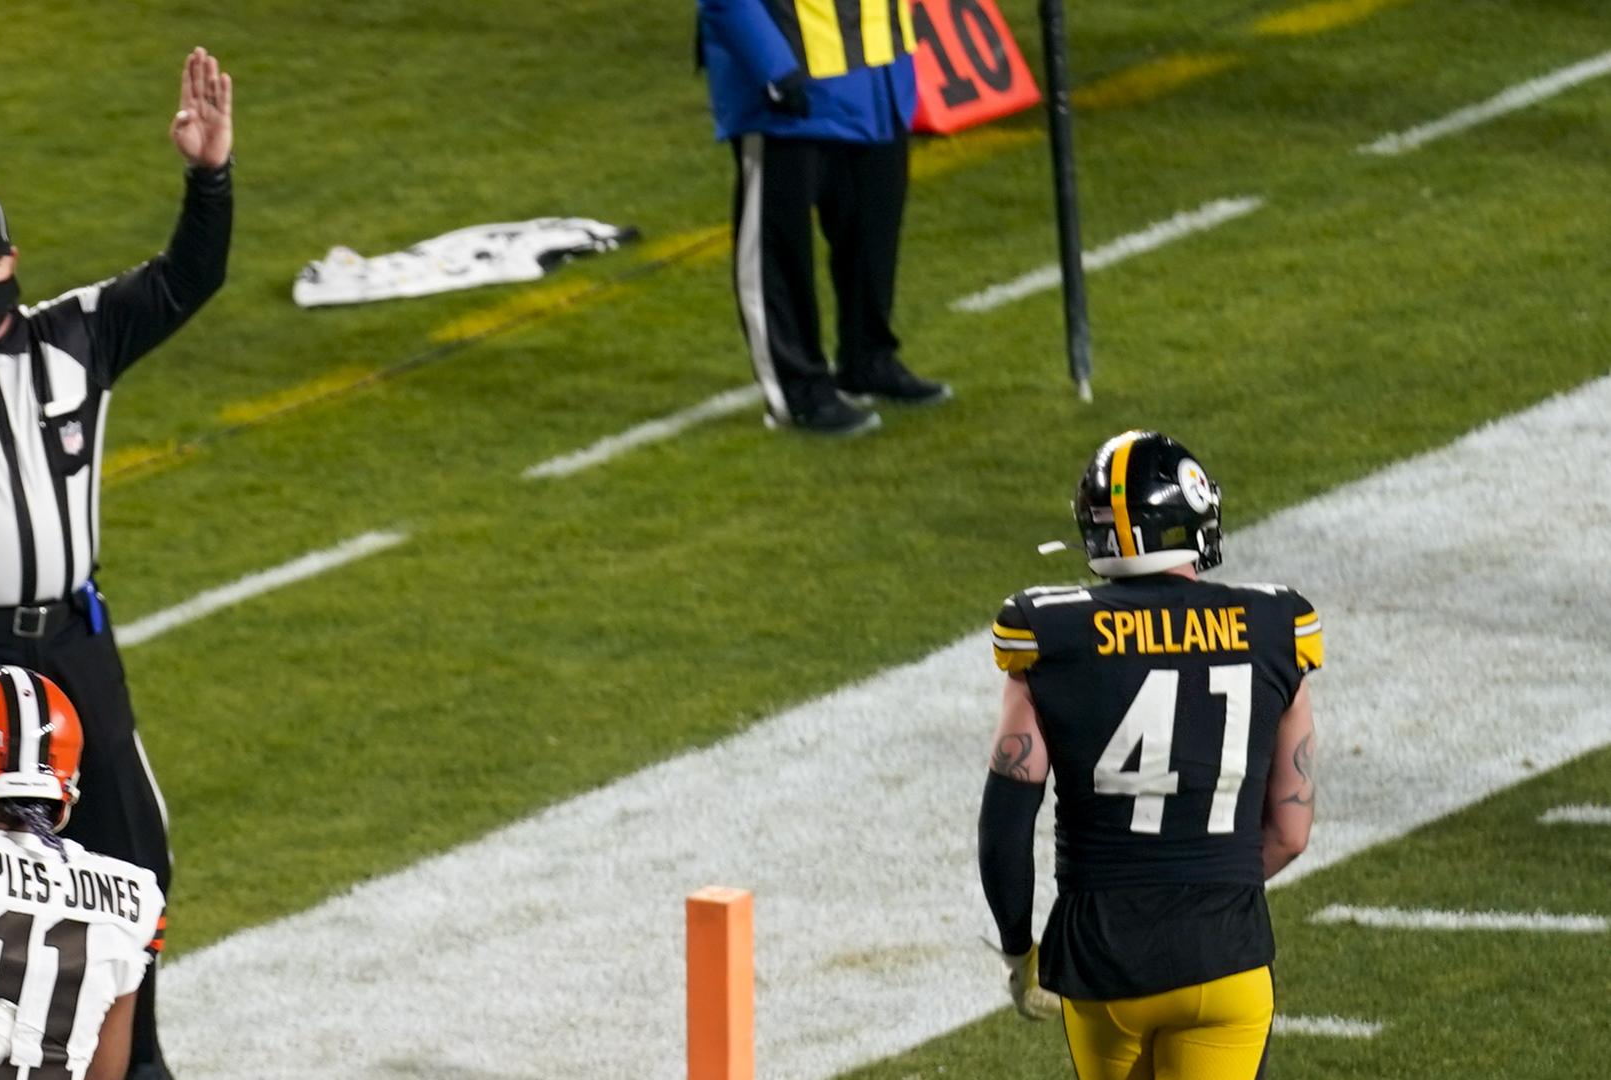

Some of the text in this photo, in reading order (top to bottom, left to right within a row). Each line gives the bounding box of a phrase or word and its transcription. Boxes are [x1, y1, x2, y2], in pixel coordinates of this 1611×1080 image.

[912, 0, 1012, 109] 10
[1106, 525, 1145, 557] 41
[1093, 606, 1249, 656] SPILLANE
[1093, 663, 1253, 834] 41
